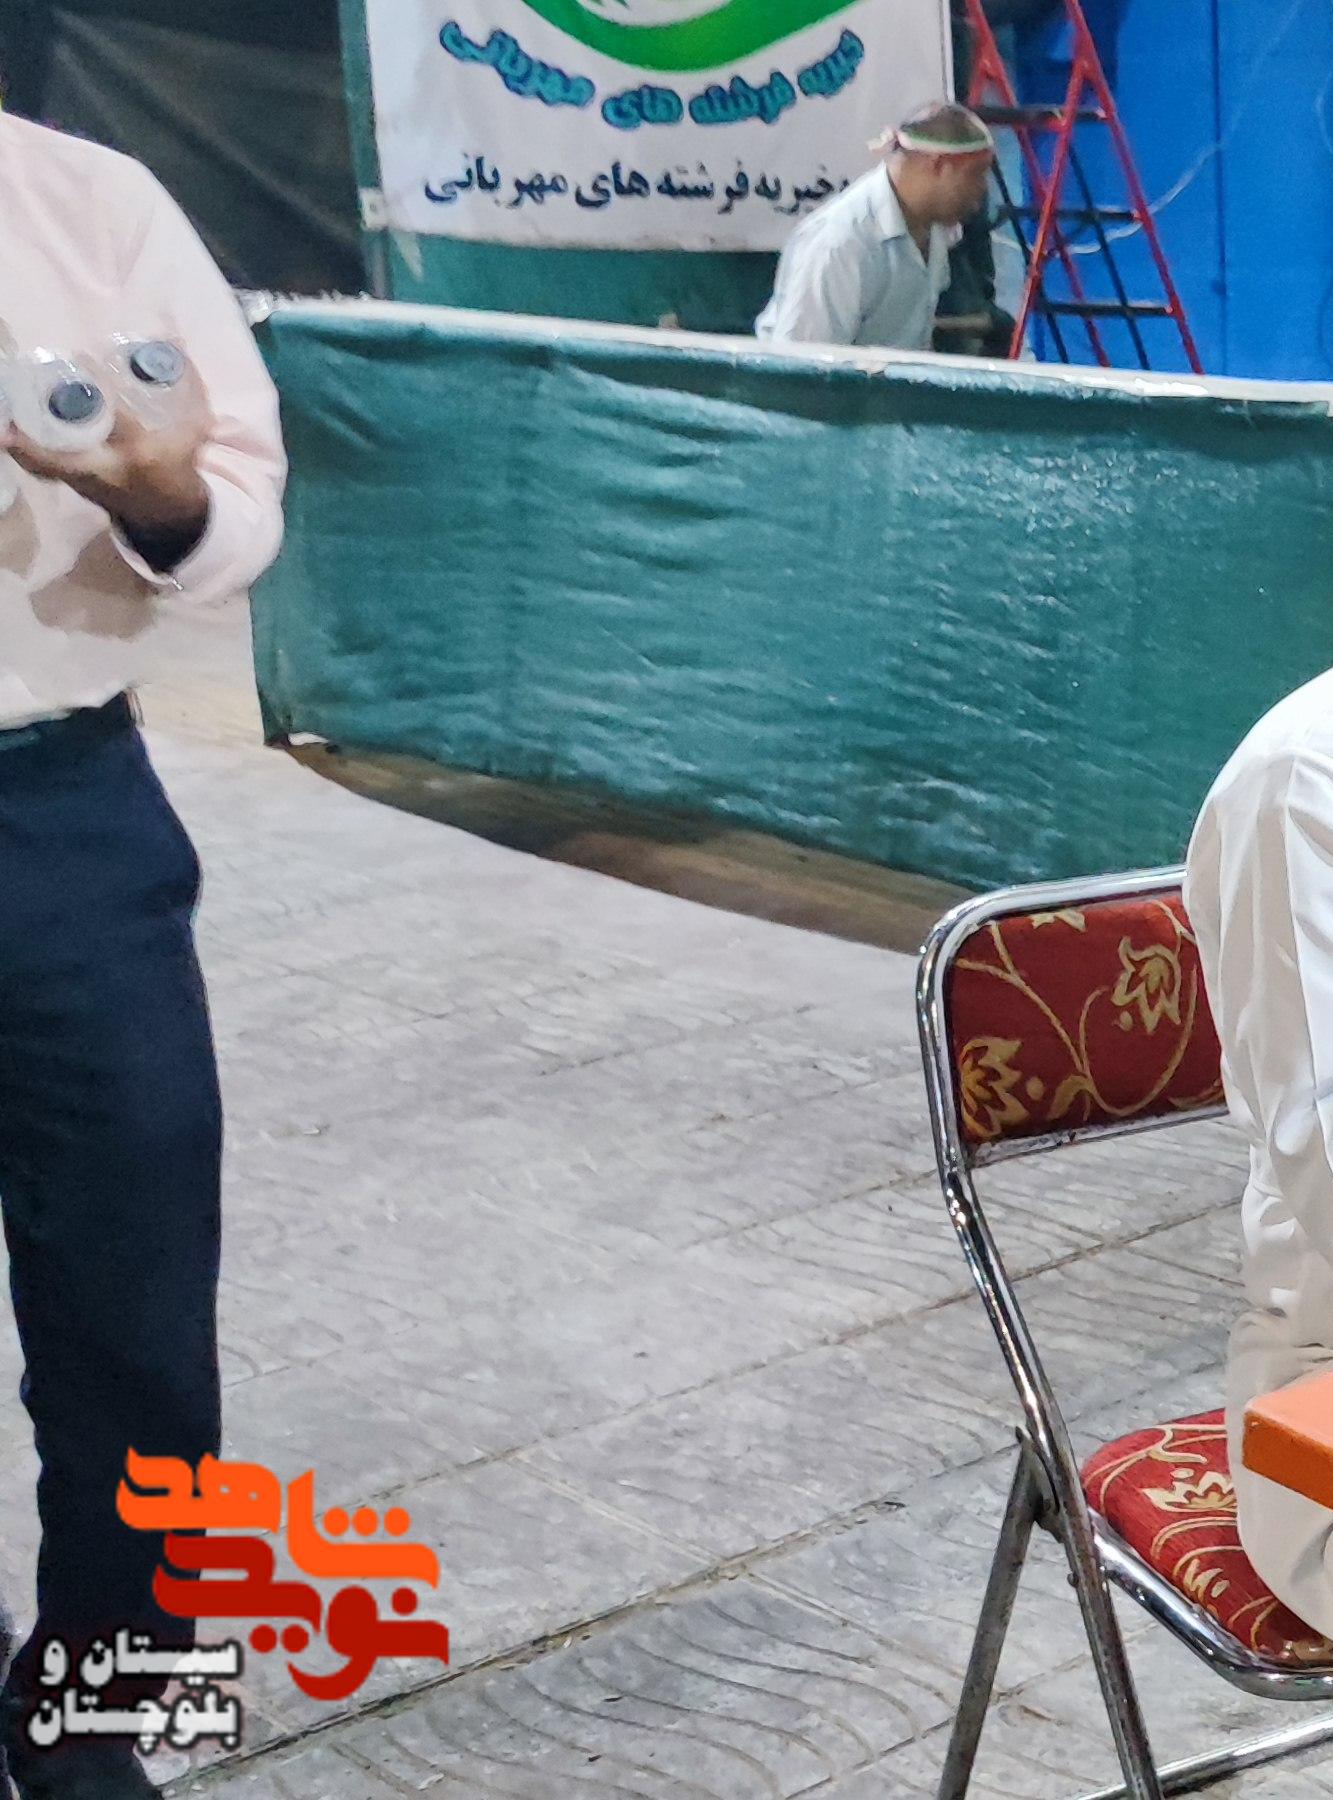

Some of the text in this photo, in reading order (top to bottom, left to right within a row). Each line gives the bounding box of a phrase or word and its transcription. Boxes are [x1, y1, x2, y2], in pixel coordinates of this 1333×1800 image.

[439, 20, 596, 107] مهربانی
[602, 84, 684, 130] های
[688, 71, 796, 124] فرشته
[575, 159, 650, 210] های
